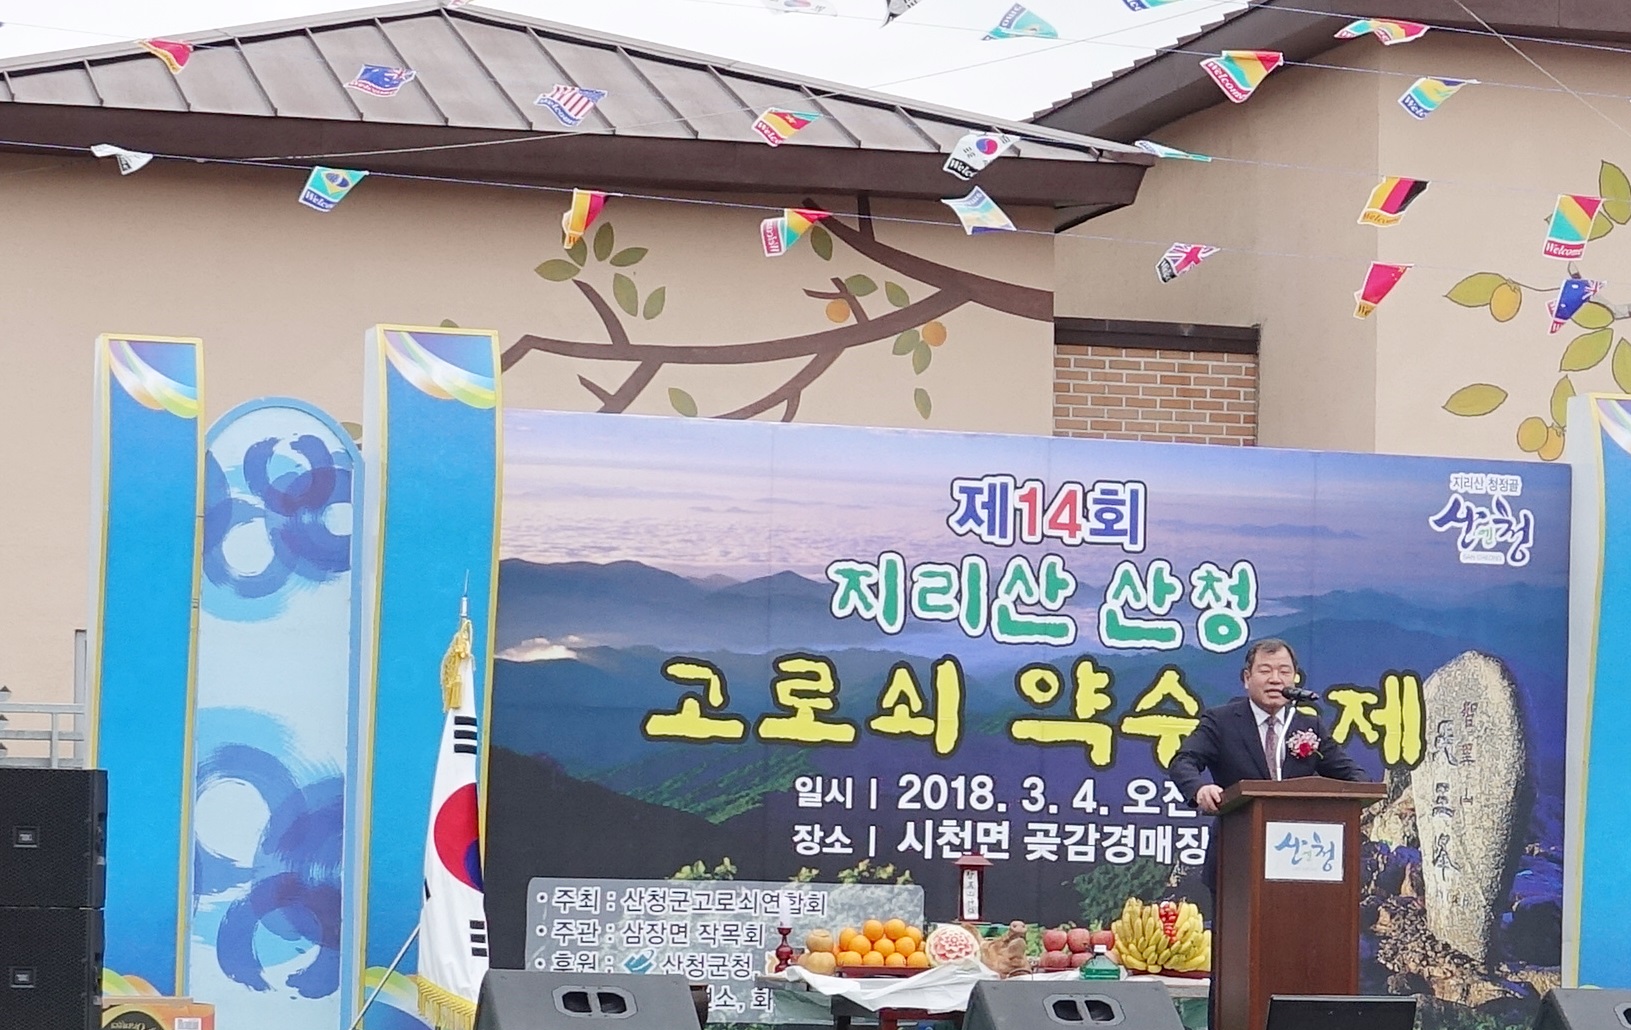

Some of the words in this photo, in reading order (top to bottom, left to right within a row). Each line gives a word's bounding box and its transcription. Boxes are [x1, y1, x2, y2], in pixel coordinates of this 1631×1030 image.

[1453, 476, 1485, 491] 지리산
[1488, 477, 1520, 493] 청정골
[951, 478, 1145, 549] 제14회
[829, 554, 1074, 643] 지리산
[1103, 562, 1256, 651] 산청
[644, 657, 962, 754] 고로쇠
[1010, 660, 1424, 767] 약수제
[795, 775, 853, 809] 일시
[897, 773, 1007, 812] 2018.
[1021, 776, 1058, 814] 3.
[1072, 778, 1109, 816] 4.
[792, 823, 853, 856] 장소
[896, 819, 1010, 860] 시천면
[1023, 822, 1210, 866] 곶감경매장
[552, 889, 601, 914] 주최
[623, 888, 827, 917] 산청군고로쇠연합회
[552, 921, 601, 945] 주관
[623, 923, 689, 946] 삼장면
[698, 923, 764, 948] 작목회
